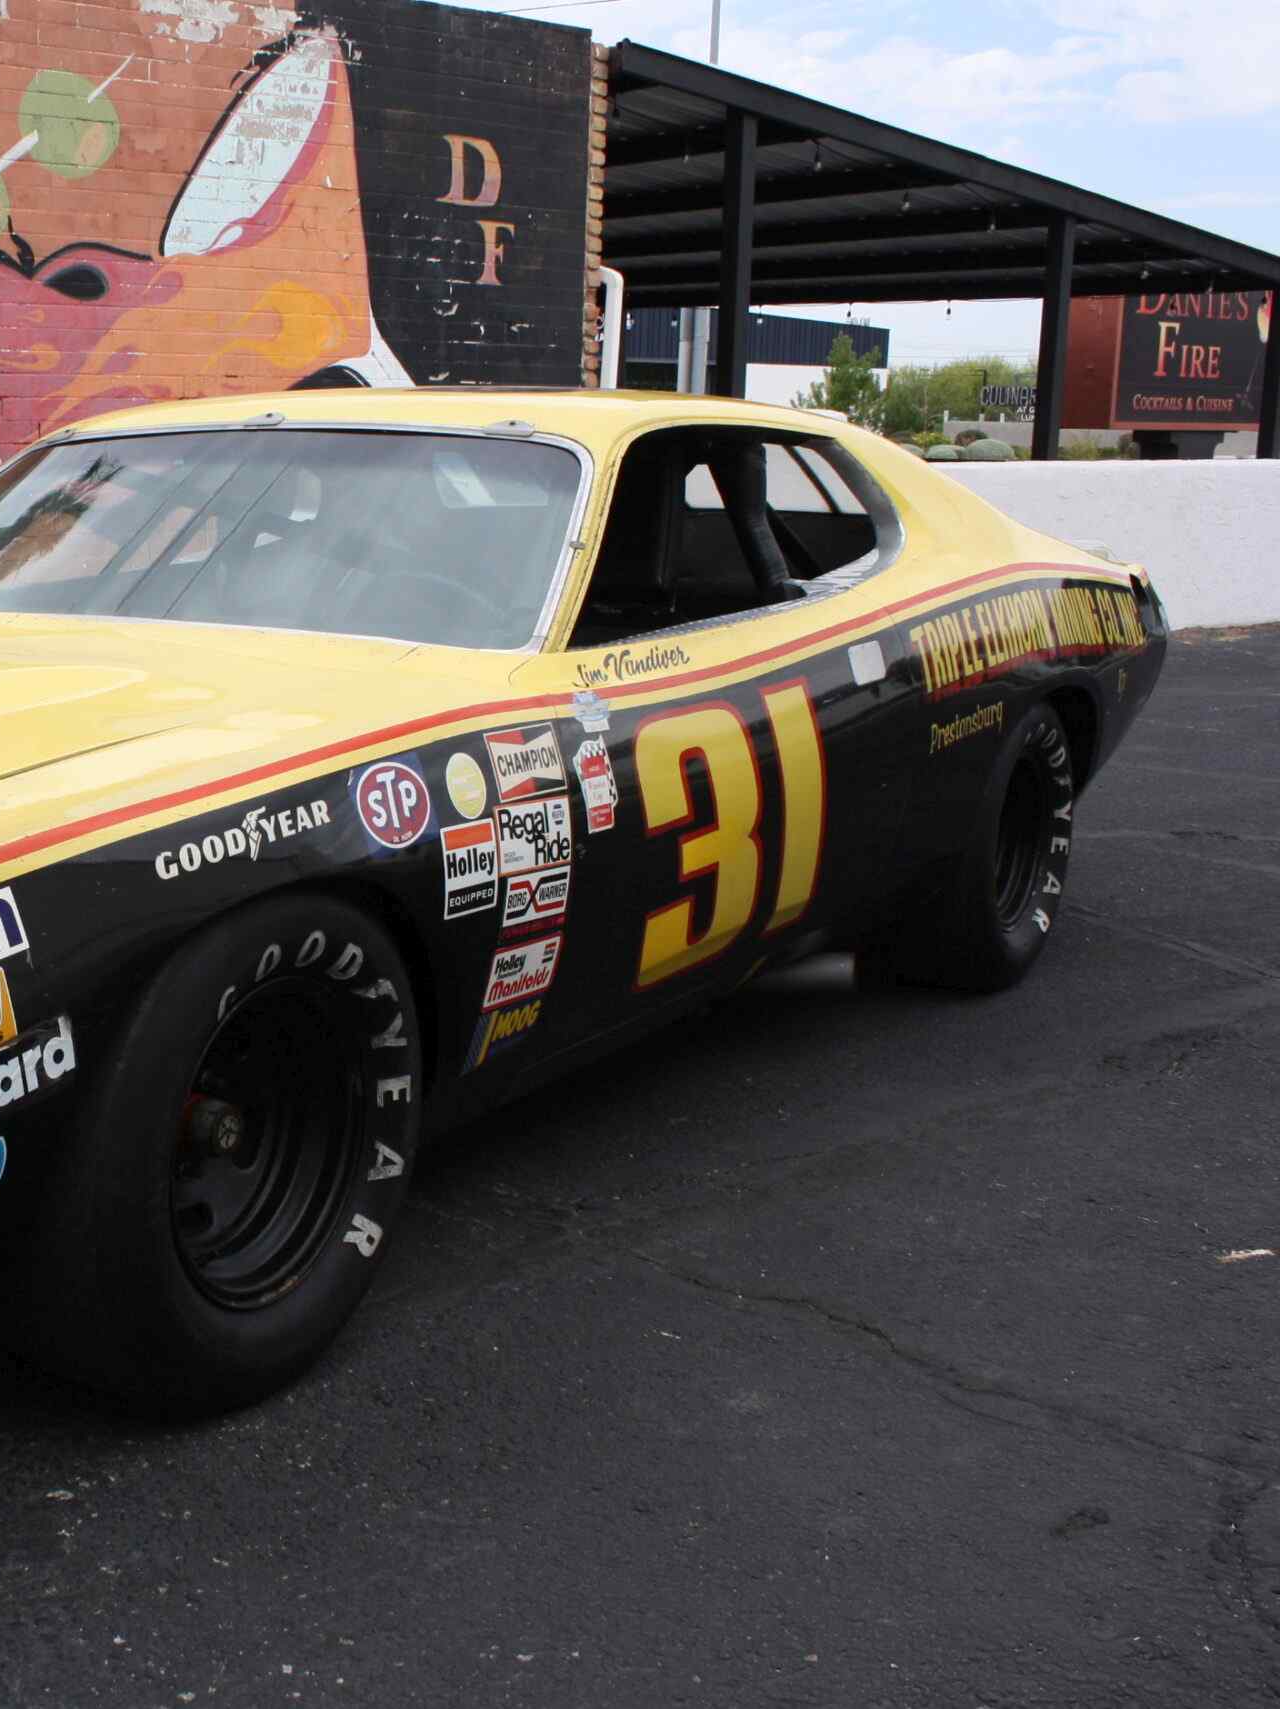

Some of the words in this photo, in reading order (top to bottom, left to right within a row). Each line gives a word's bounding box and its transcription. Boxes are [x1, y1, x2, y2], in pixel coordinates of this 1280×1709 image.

[434, 134, 502, 207] D
[475, 219, 516, 286] F
[1153, 321, 1221, 378] FIRE
[1133, 393, 1184, 412] COCKTAILS
[1196, 395, 1233, 411] CUISINE
[910, 608, 985, 694] TRIPLE
[975, 588, 1056, 669] ELKHORN
[572, 663, 608, 688] Jim
[603, 645, 690, 681] Vandiver
[929, 701, 1003, 755] Prestonsburg
[497, 745, 558, 777] CHAMPION
[368, 768, 417, 828] STP
[155, 800, 330, 880] GOODYEAR
[498, 802, 549, 844] Regal
[632, 675, 827, 993] 31
[446, 847, 495, 880] Holley
[534, 831, 570, 865] Ride
[449, 888, 494, 908] EQUIPPED
[507, 890, 528, 909] BORG
[538, 882, 567, 902] WARNER
[487, 967, 550, 1002] Manifolds
[494, 953, 527, 976] Holley
[493, 999, 543, 1042] MOOG
